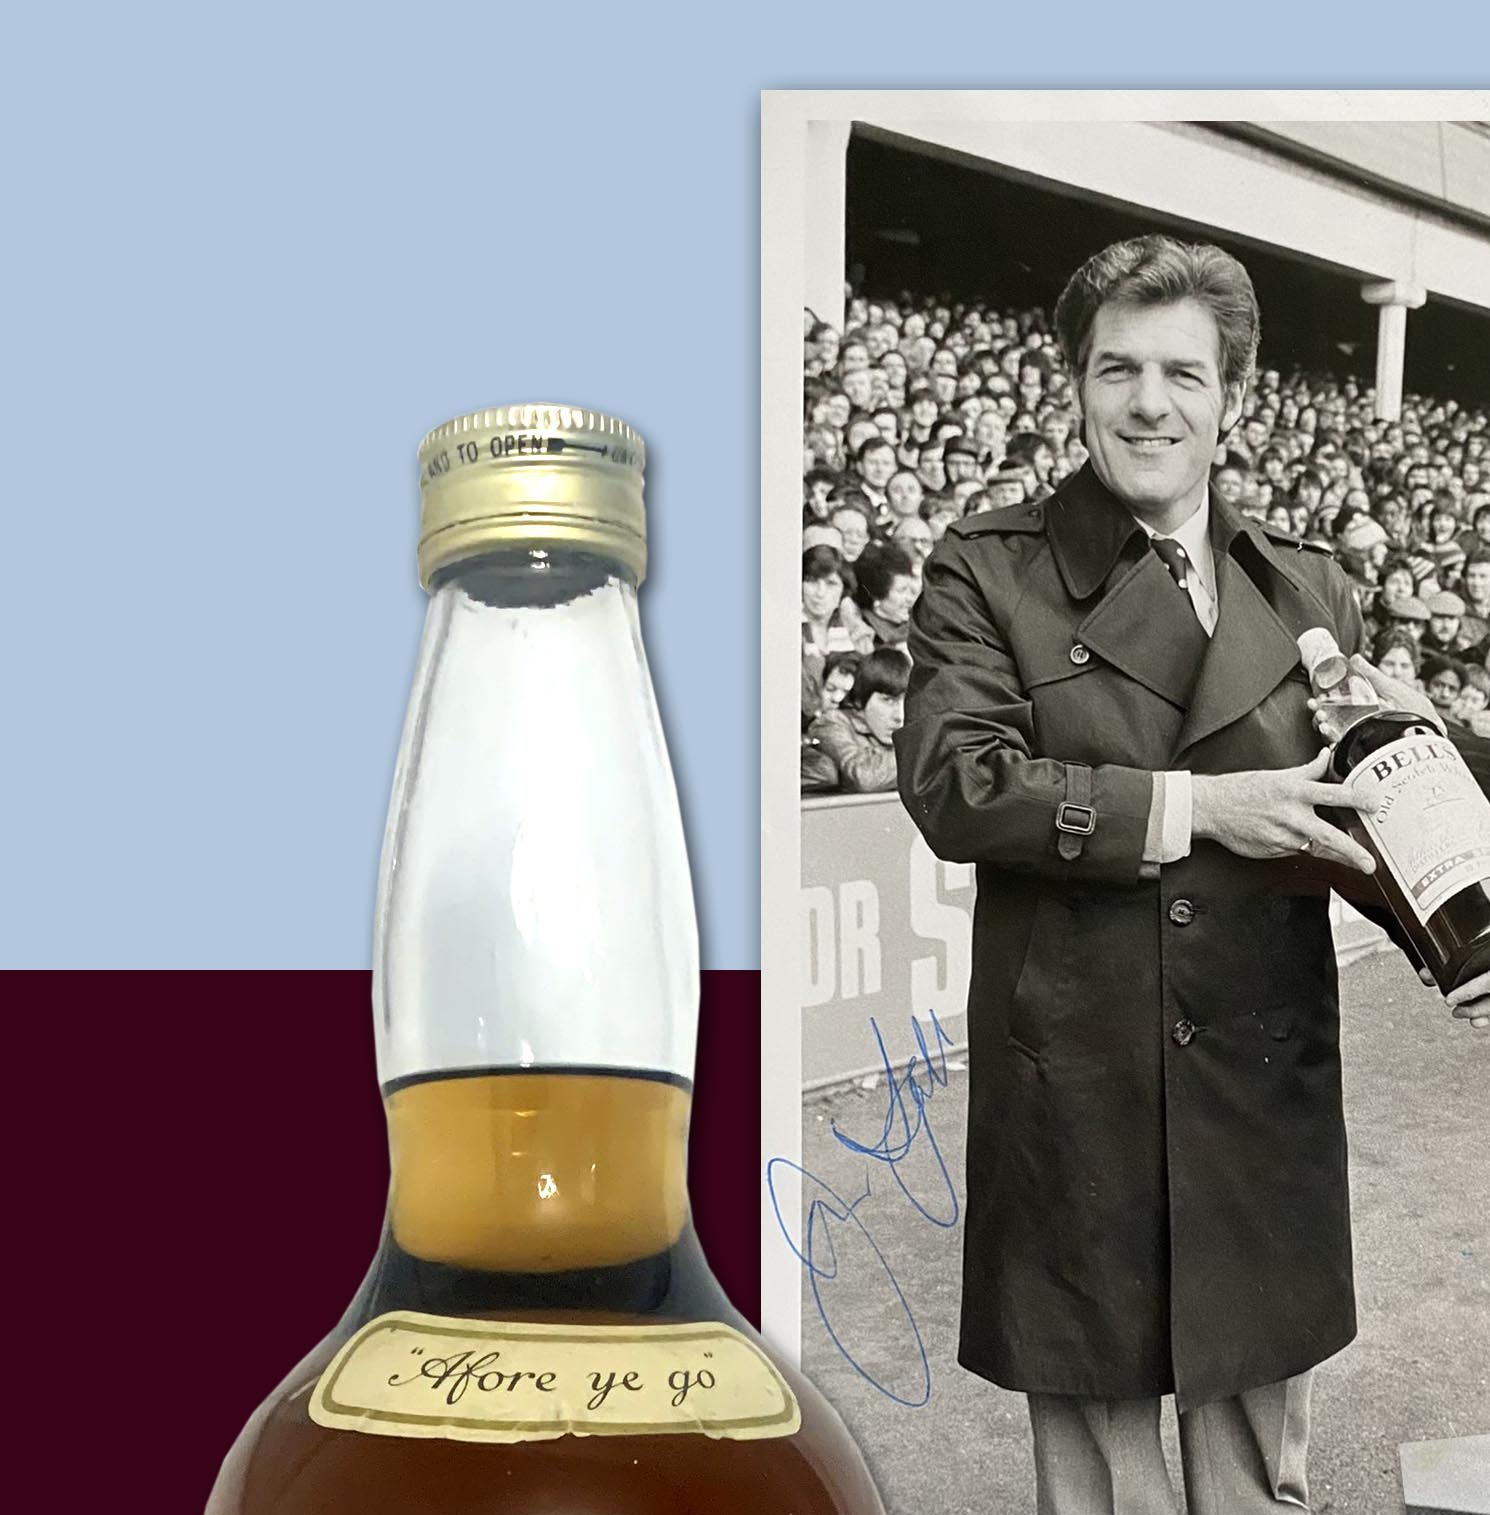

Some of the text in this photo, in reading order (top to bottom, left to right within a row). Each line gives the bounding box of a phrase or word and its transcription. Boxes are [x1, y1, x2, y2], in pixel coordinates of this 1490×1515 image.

[457, 441, 479, 464] TO
[490, 435, 543, 458] OPEN
[1371, 744, 1457, 782] BELL'S
[589, 1373, 644, 1409] ye
